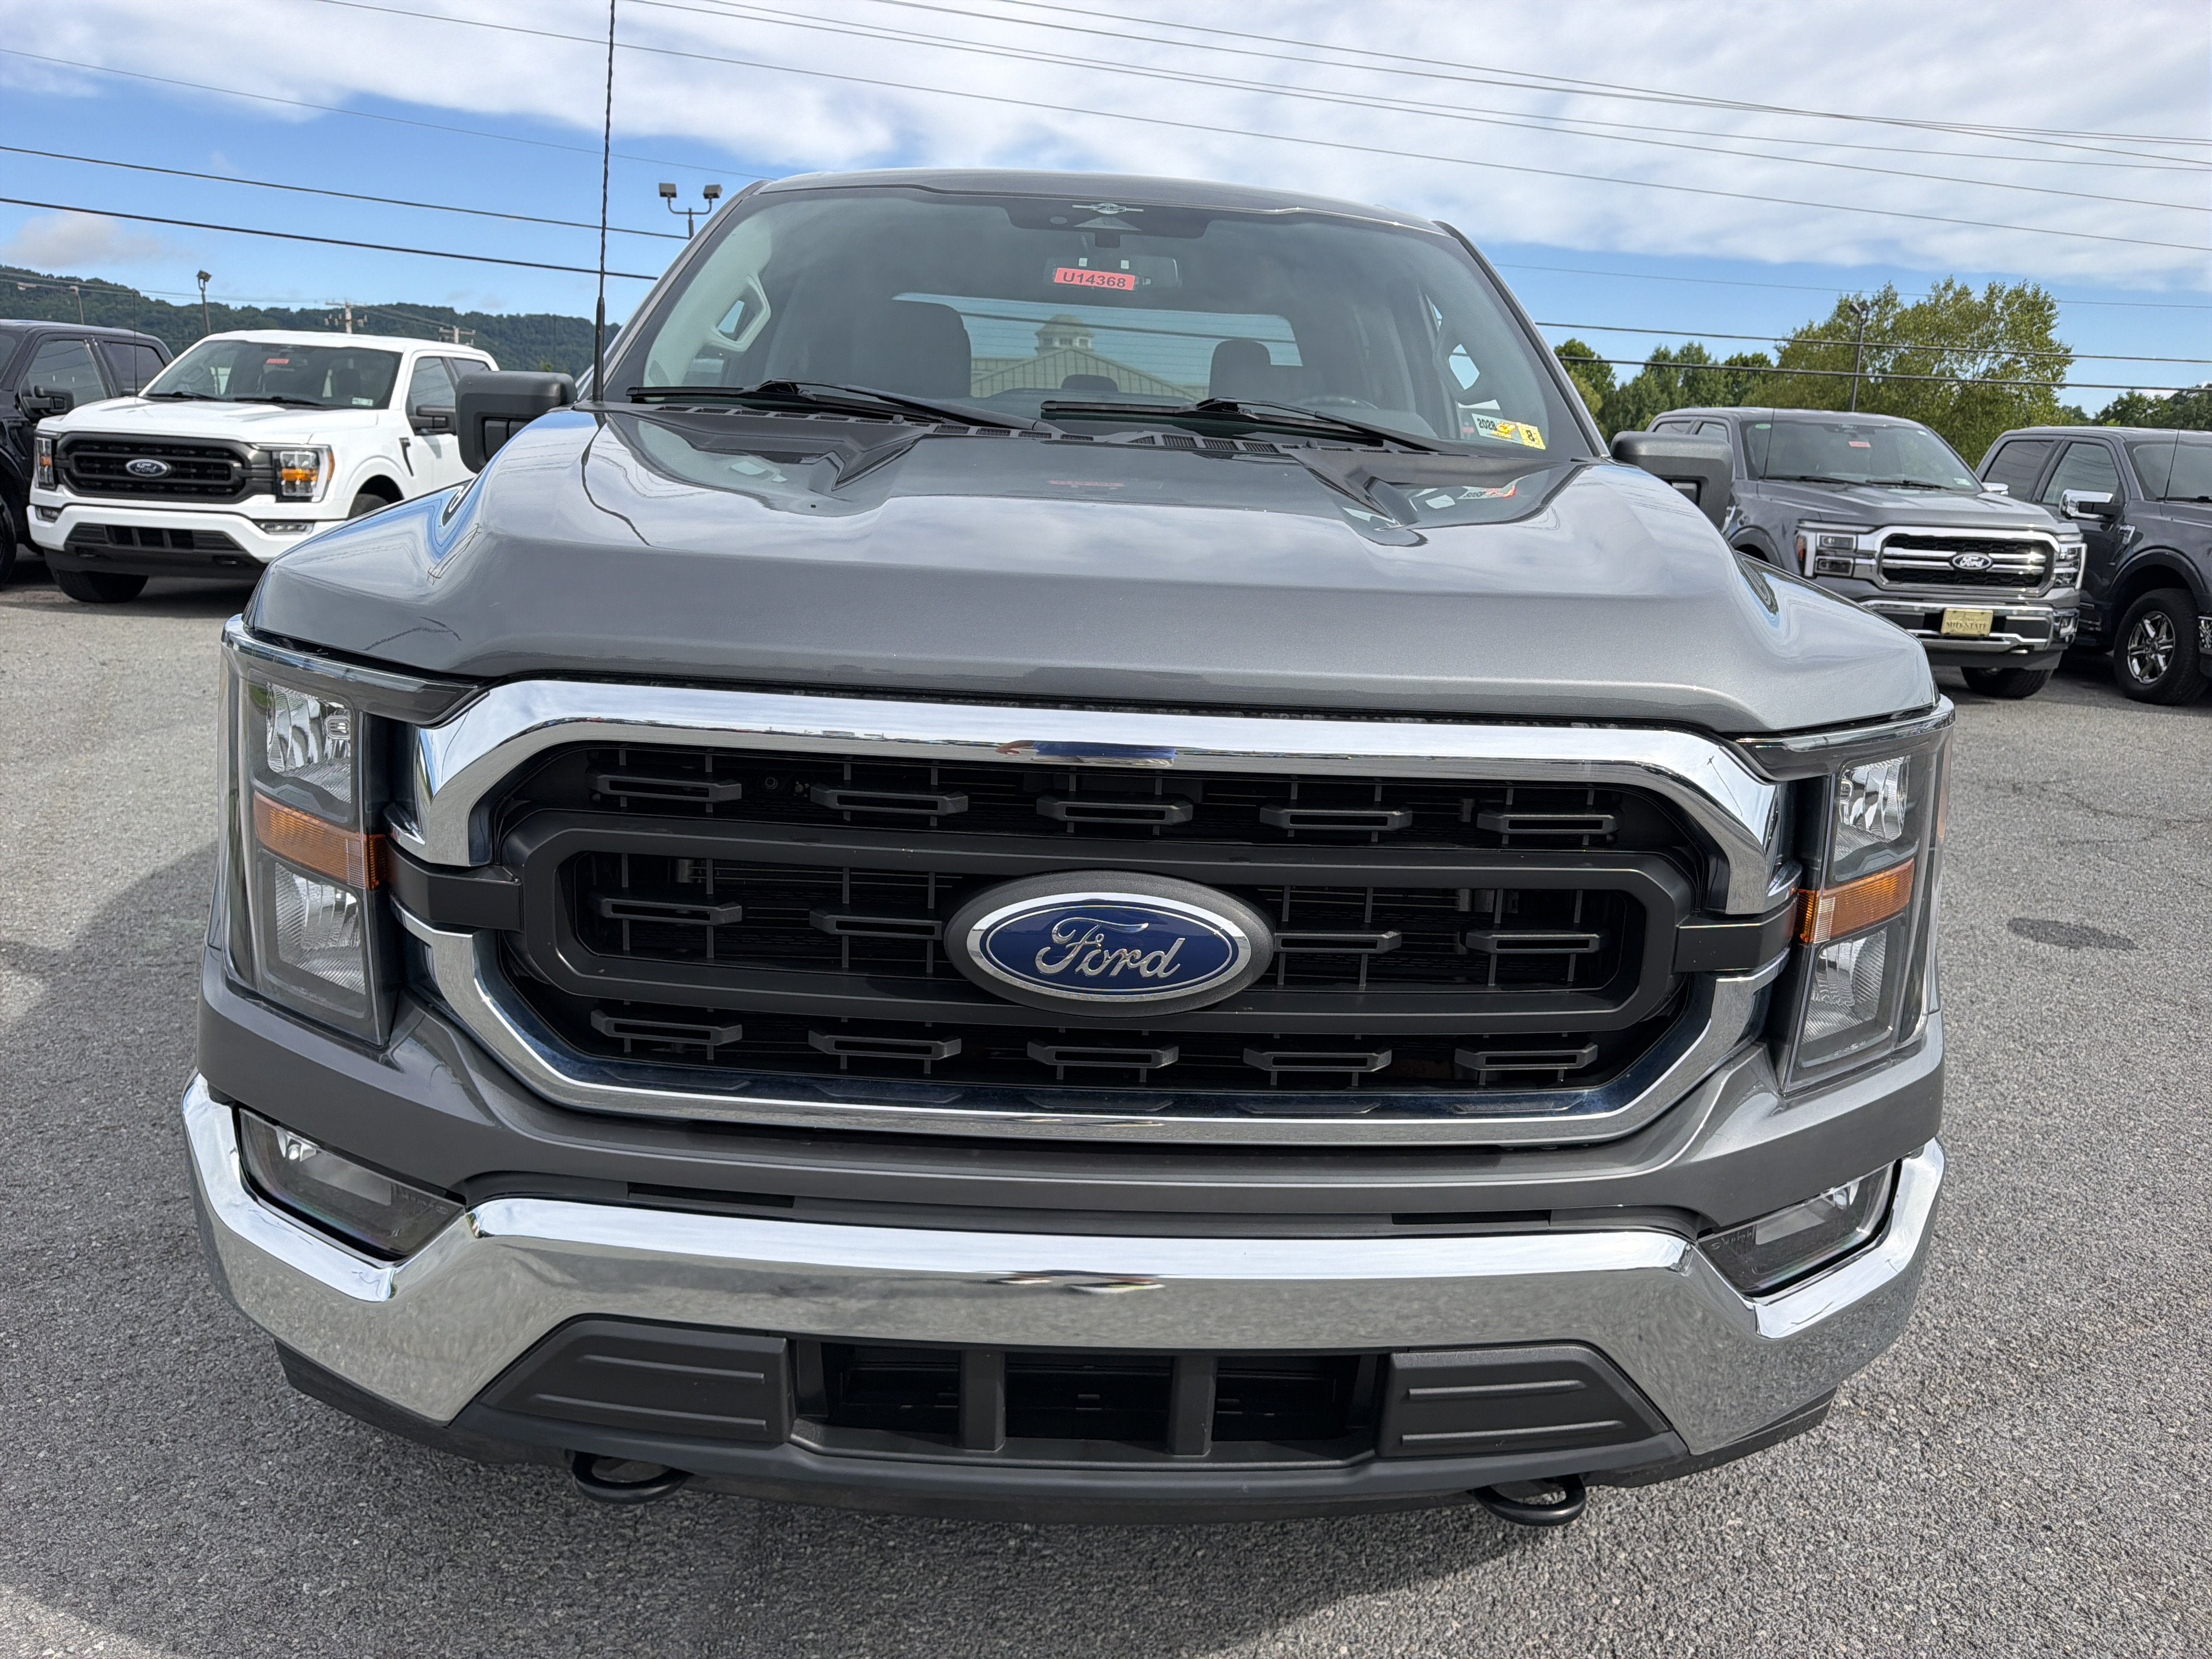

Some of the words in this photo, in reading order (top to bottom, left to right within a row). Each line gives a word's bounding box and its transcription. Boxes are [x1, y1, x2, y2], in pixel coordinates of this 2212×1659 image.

[1063, 272, 1126, 287] U14368
[1477, 417, 1497, 431] 2028
[1526, 430, 1535, 442] 8
[136, 462, 157, 472] Ford
[1960, 555, 1984, 567] Ford
[1035, 916, 1186, 979] Ford
